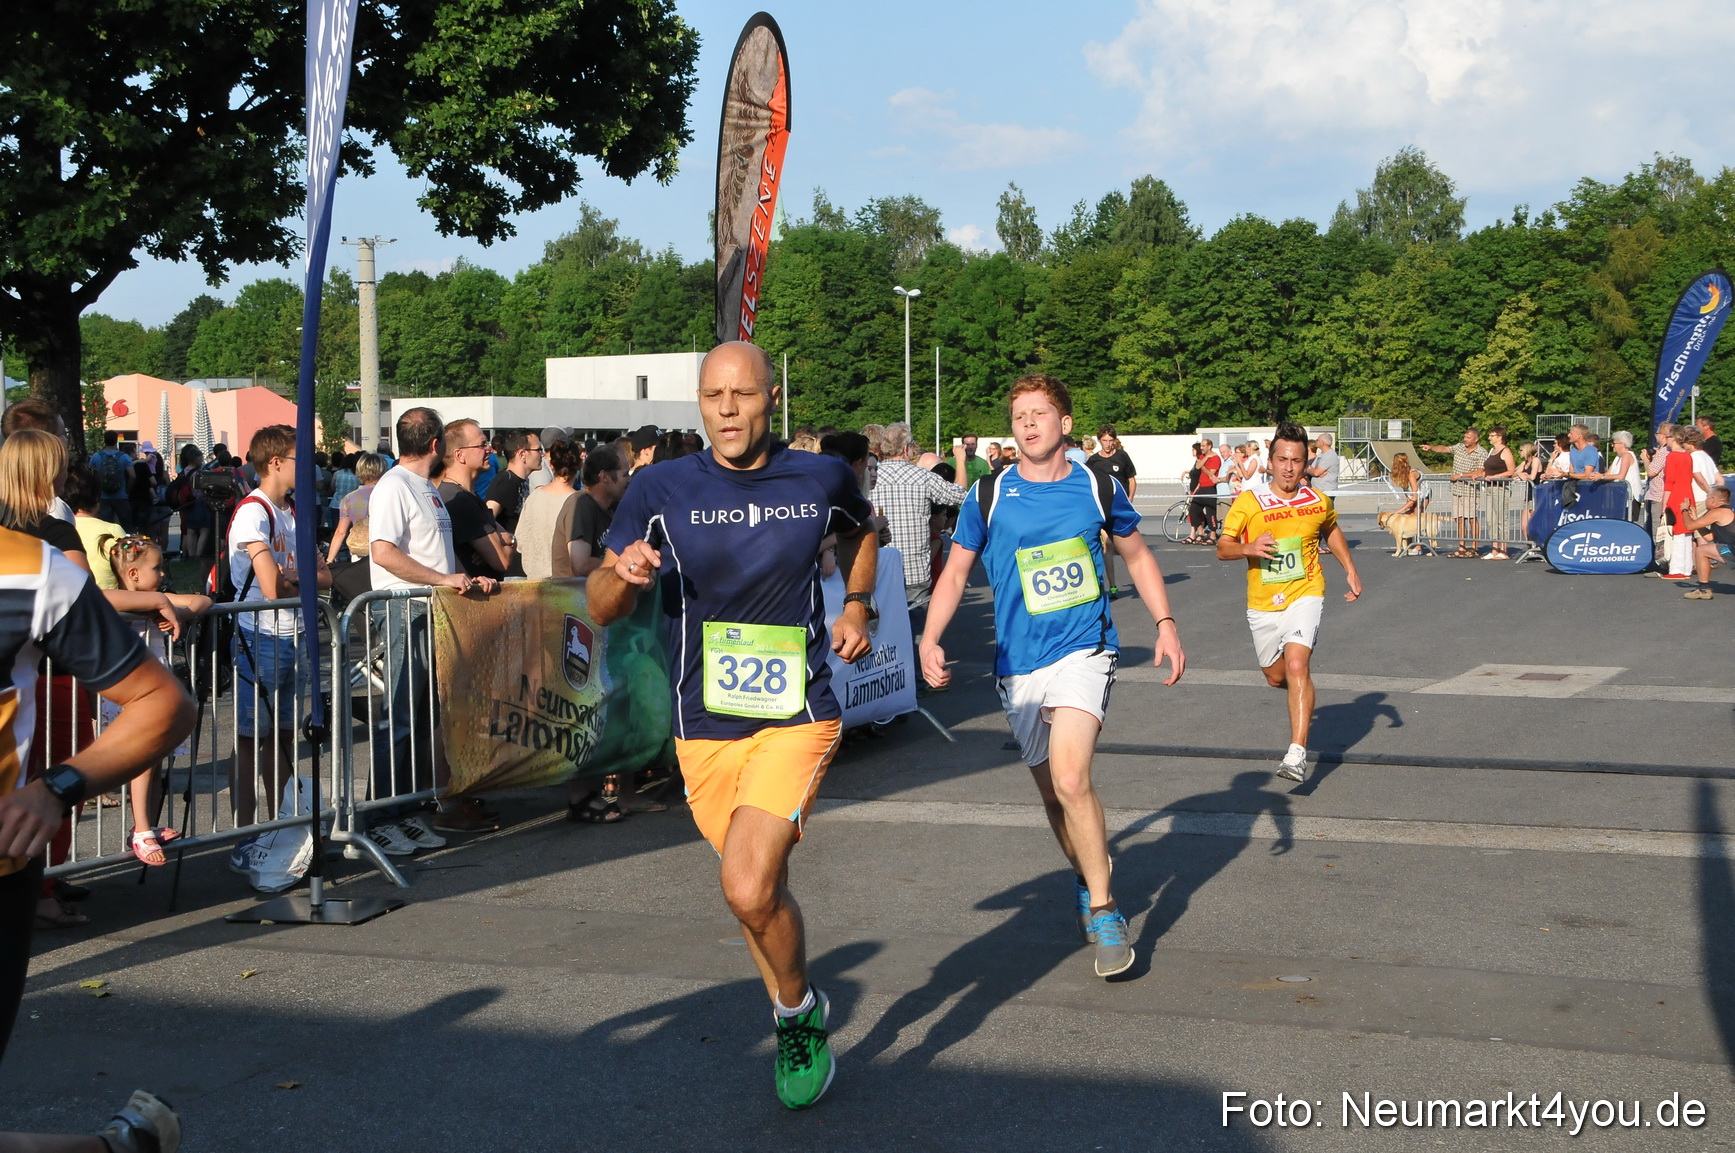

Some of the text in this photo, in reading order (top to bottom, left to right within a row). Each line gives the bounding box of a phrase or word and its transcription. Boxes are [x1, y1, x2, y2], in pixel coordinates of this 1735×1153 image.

[1263, 505, 1327, 523] MAX BÖGL
[1573, 542, 1641, 556] Fischer
[1580, 555, 1636, 563] AUTOMOBILE
[1032, 562, 1084, 596] 639
[854, 644, 897, 675] Neumarkter
[717, 655, 787, 695] 328
[845, 665, 906, 710] Lammsbräu
[720, 700, 743, 708] Europoles
[743, 695, 777, 703] Friedwagner
